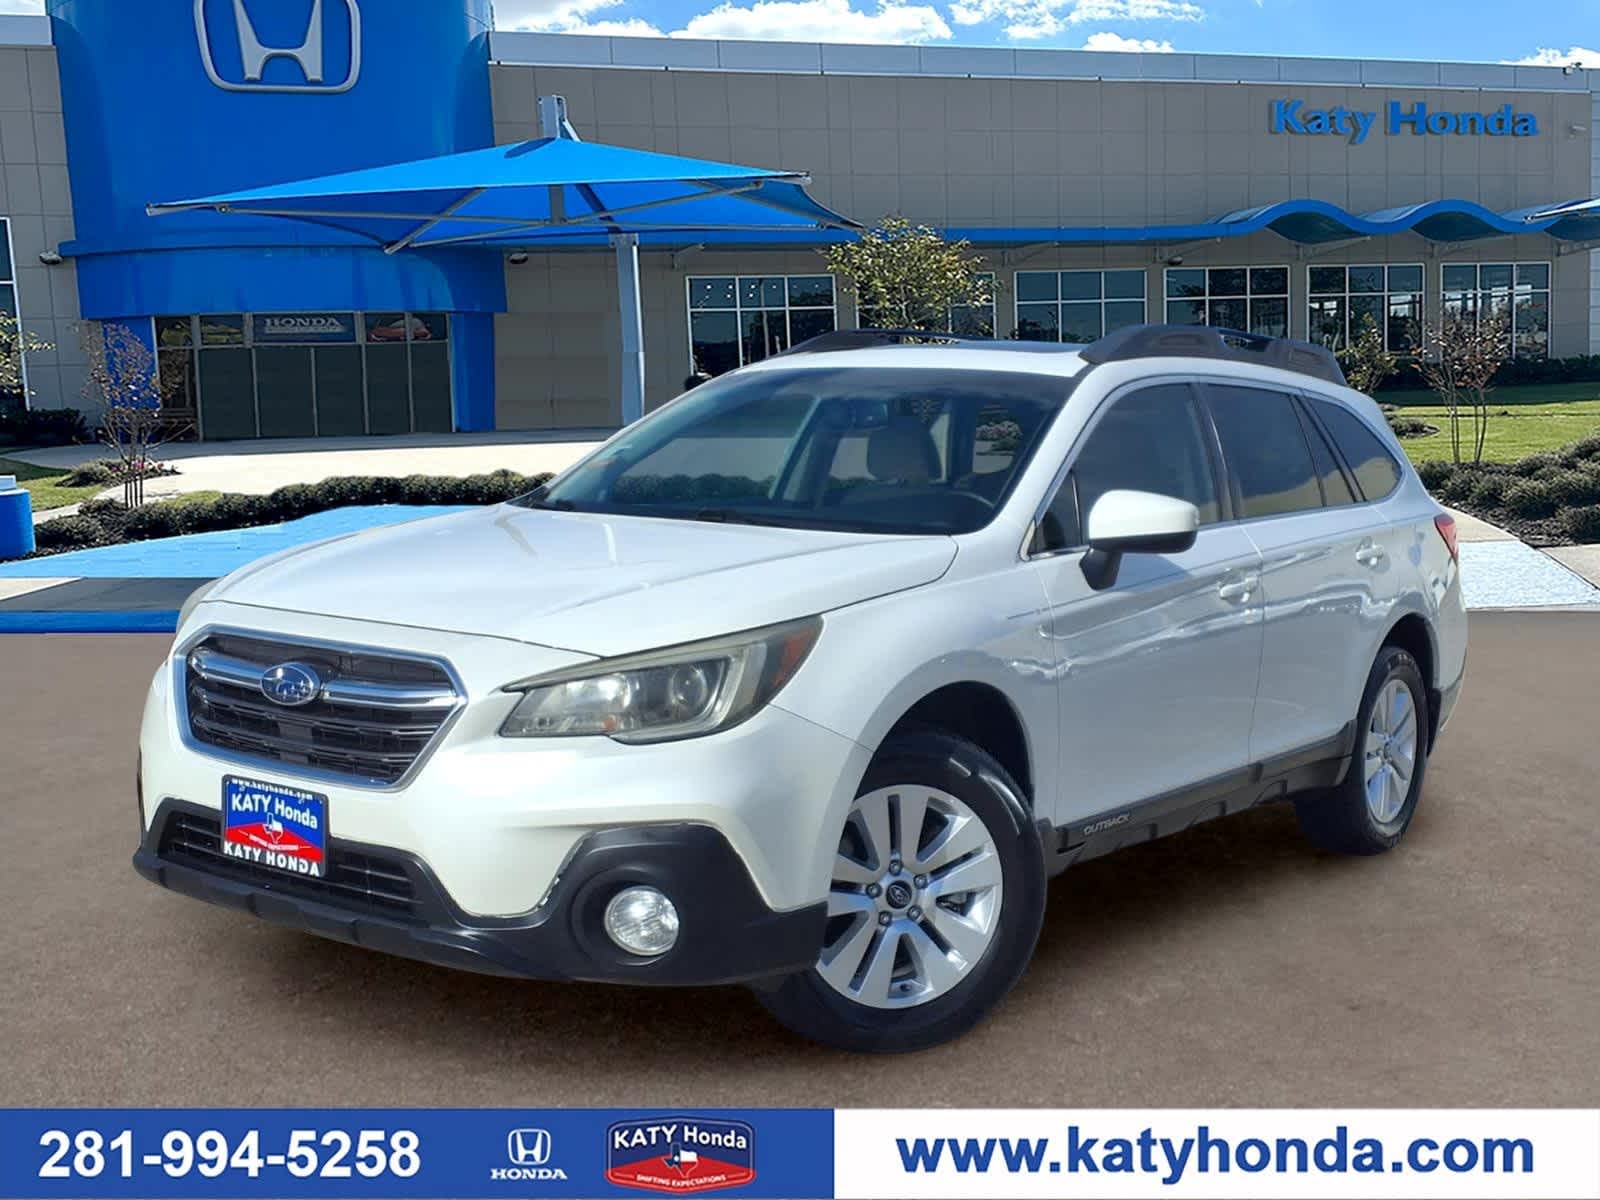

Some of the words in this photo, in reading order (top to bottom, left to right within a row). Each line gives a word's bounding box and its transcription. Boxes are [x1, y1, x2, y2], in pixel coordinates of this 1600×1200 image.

[1270, 99, 1376, 144] Katy
[1386, 101, 1540, 136] Honda
[264, 317, 343, 328] HONDA
[231, 793, 272, 813] KATY
[274, 797, 318, 830] Honda
[1083, 813, 1129, 836] OUTBACK
[223, 840, 261, 862] KATY
[265, 851, 320, 877] HONDA
